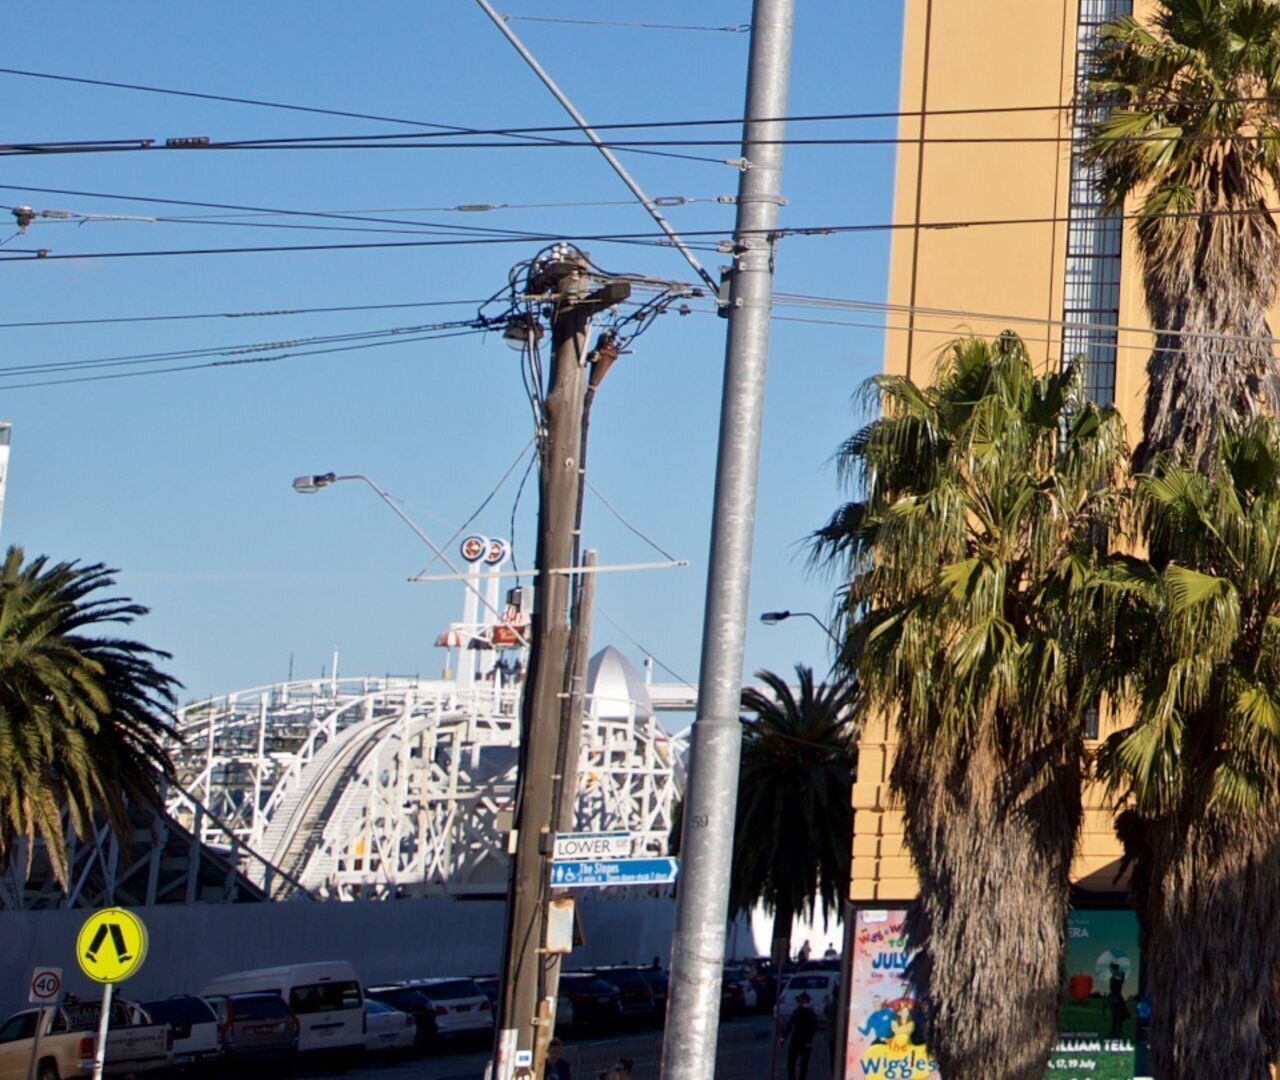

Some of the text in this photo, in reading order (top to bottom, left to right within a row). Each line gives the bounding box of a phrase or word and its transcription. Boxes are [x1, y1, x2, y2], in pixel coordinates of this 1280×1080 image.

[558, 839, 610, 855] LOWER
[1068, 928, 1089, 938] ERA
[872, 952, 908, 969] JULY
[36, 978, 55, 991] 40
[1055, 1039, 1134, 1052] ILLIAM TELL
[861, 1050, 937, 1080] Wiggles
[1079, 1059, 1097, 1070] July
